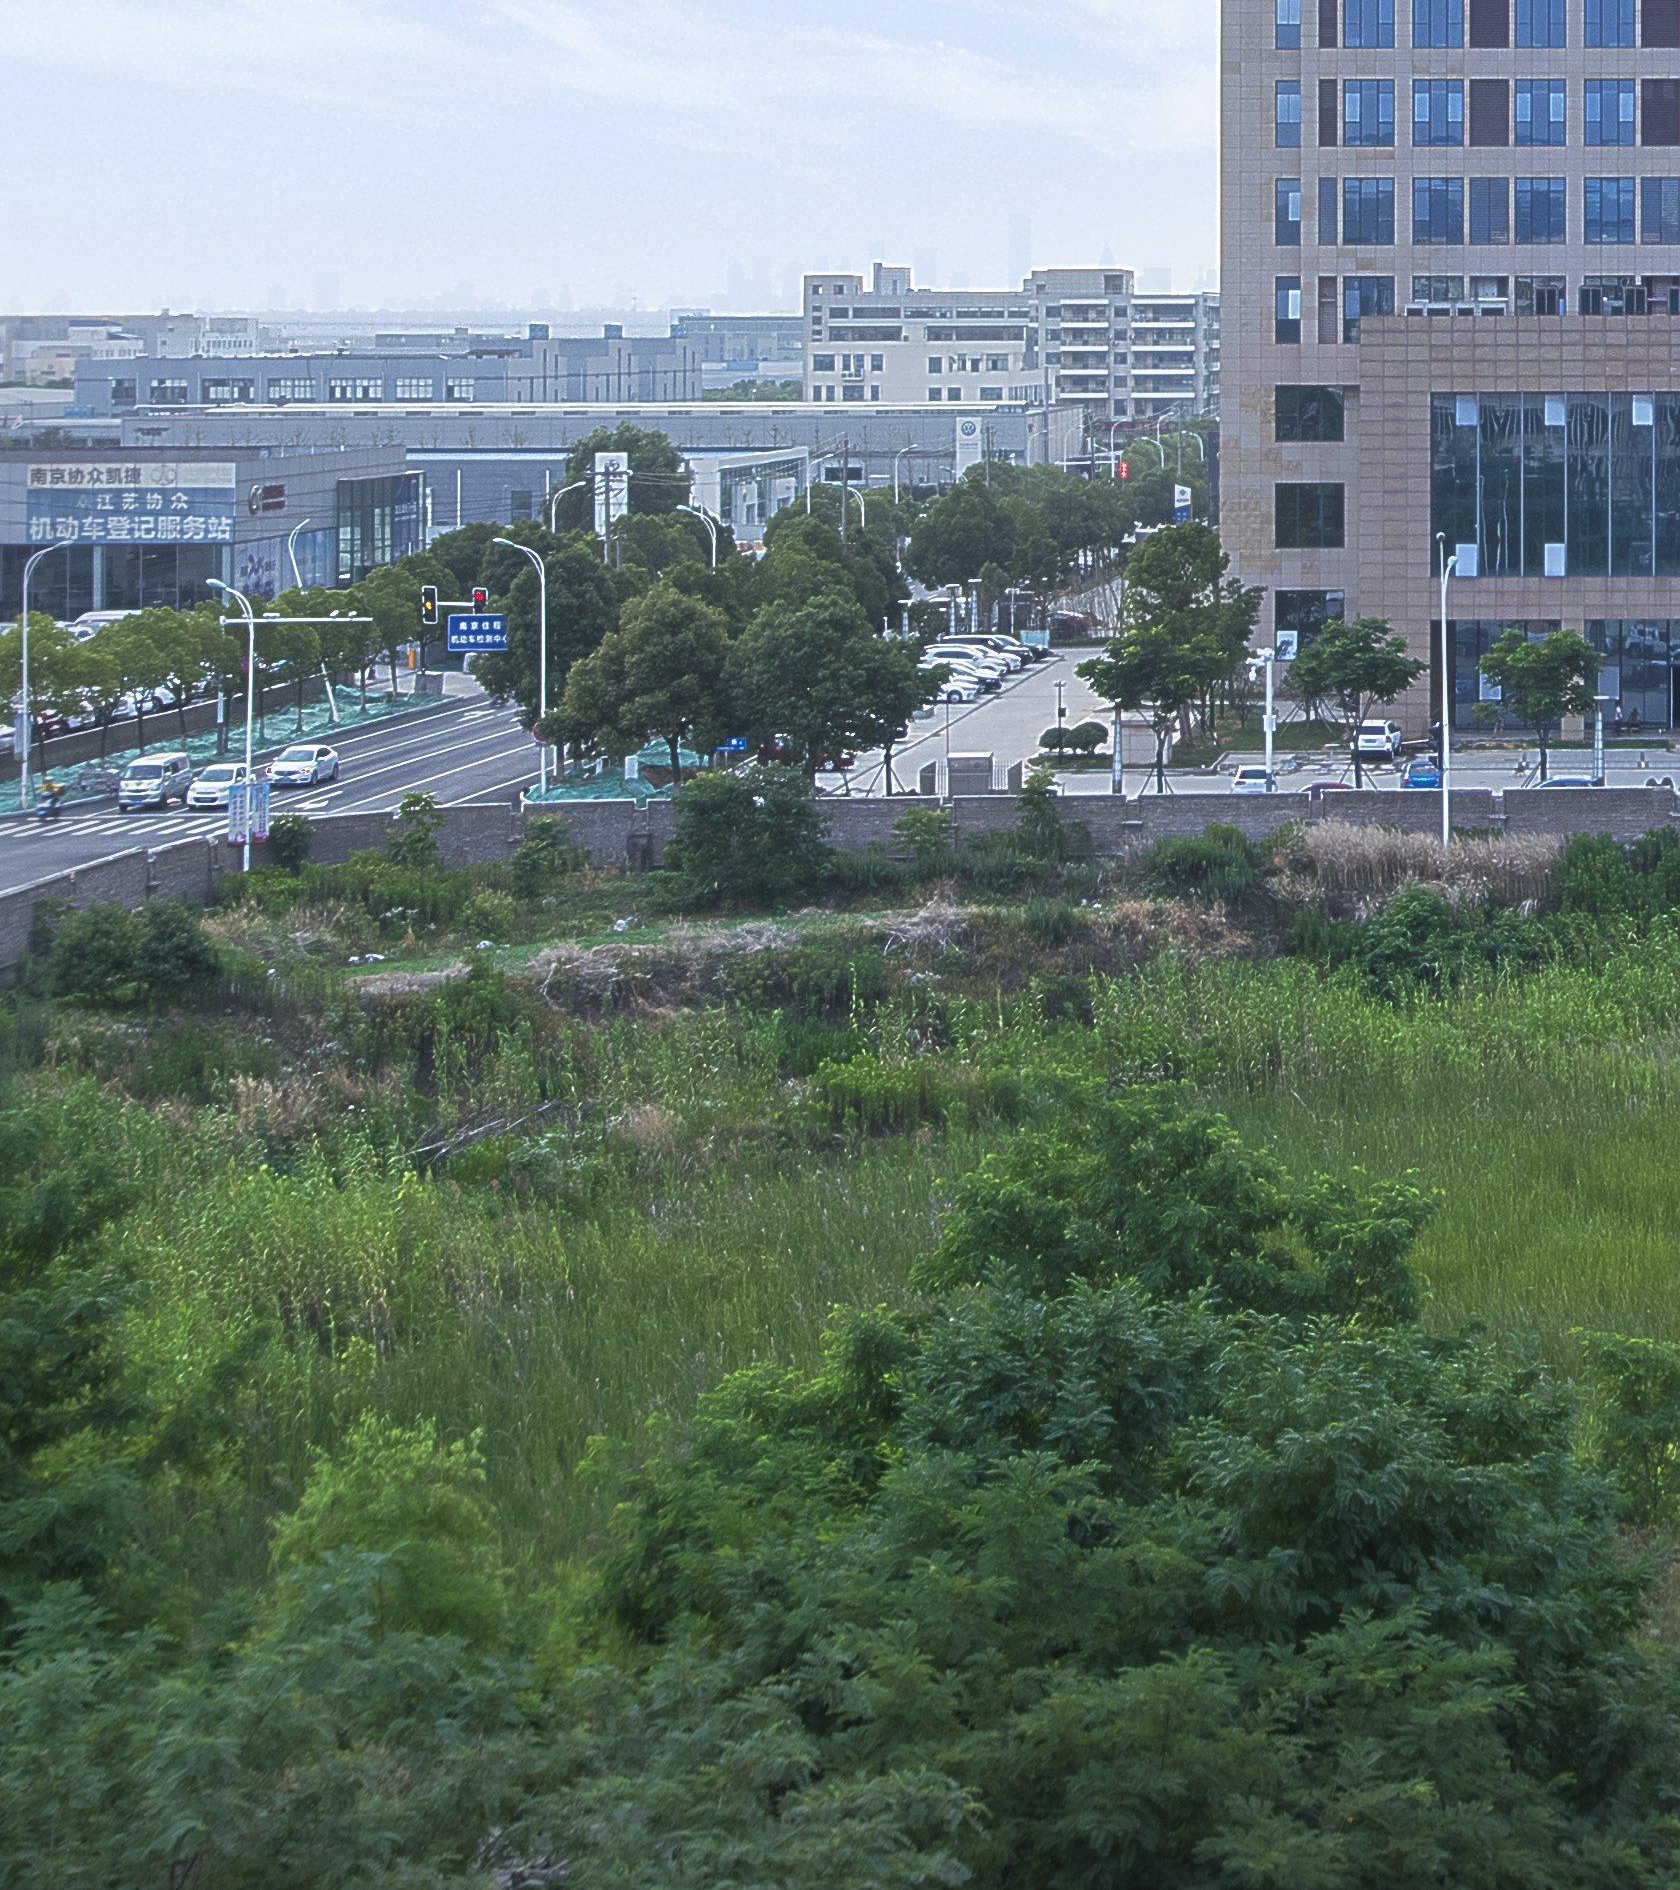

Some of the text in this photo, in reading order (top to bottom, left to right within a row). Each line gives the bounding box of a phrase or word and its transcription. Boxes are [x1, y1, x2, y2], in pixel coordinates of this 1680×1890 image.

[30, 467, 142, 486] 南京协众凯捷
[96, 492, 189, 510] 江苏协众
[30, 516, 231, 540] 机动车登记服务站
